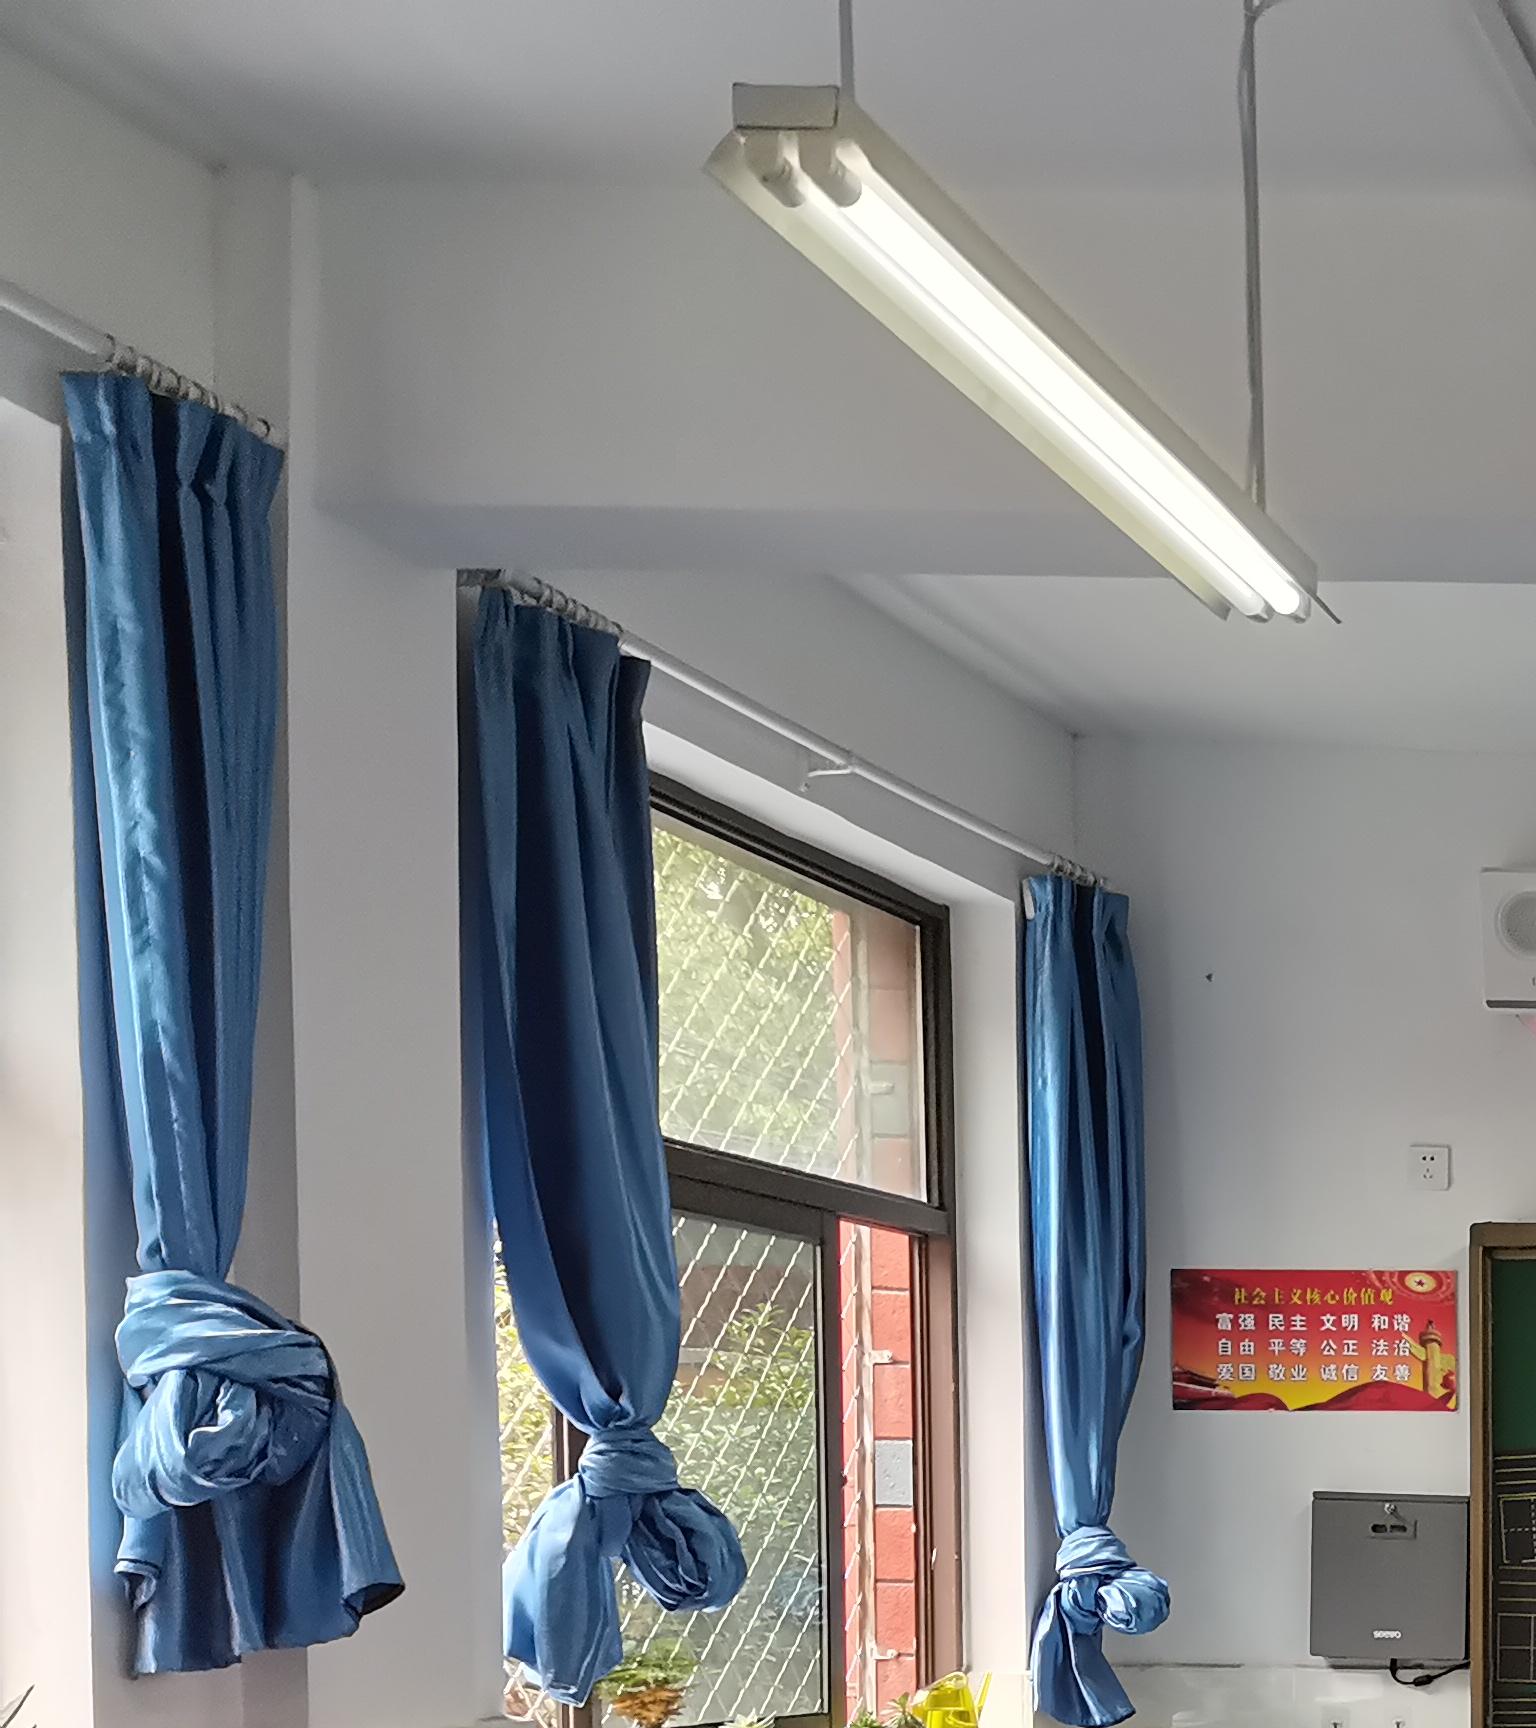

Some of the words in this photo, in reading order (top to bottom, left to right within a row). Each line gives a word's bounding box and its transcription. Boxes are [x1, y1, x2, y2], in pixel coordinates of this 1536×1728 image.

[1234, 1287, 1395, 1306] 社会主义核心价值观
[1216, 1312, 1256, 1332] 富强
[1268, 1313, 1308, 1332] 民主
[1319, 1313, 1360, 1332] 文明
[1371, 1313, 1411, 1333] 和谐
[1217, 1338, 1255, 1356] 自由
[1268, 1338, 1308, 1357] 平等
[1320, 1339, 1359, 1356] 公正
[1371, 1338, 1411, 1357] 法治
[1217, 1363, 1256, 1381] 爱国
[1268, 1363, 1308, 1381] 敬业
[1320, 1363, 1359, 1382] 诚信
[1371, 1363, 1411, 1382] 友善
